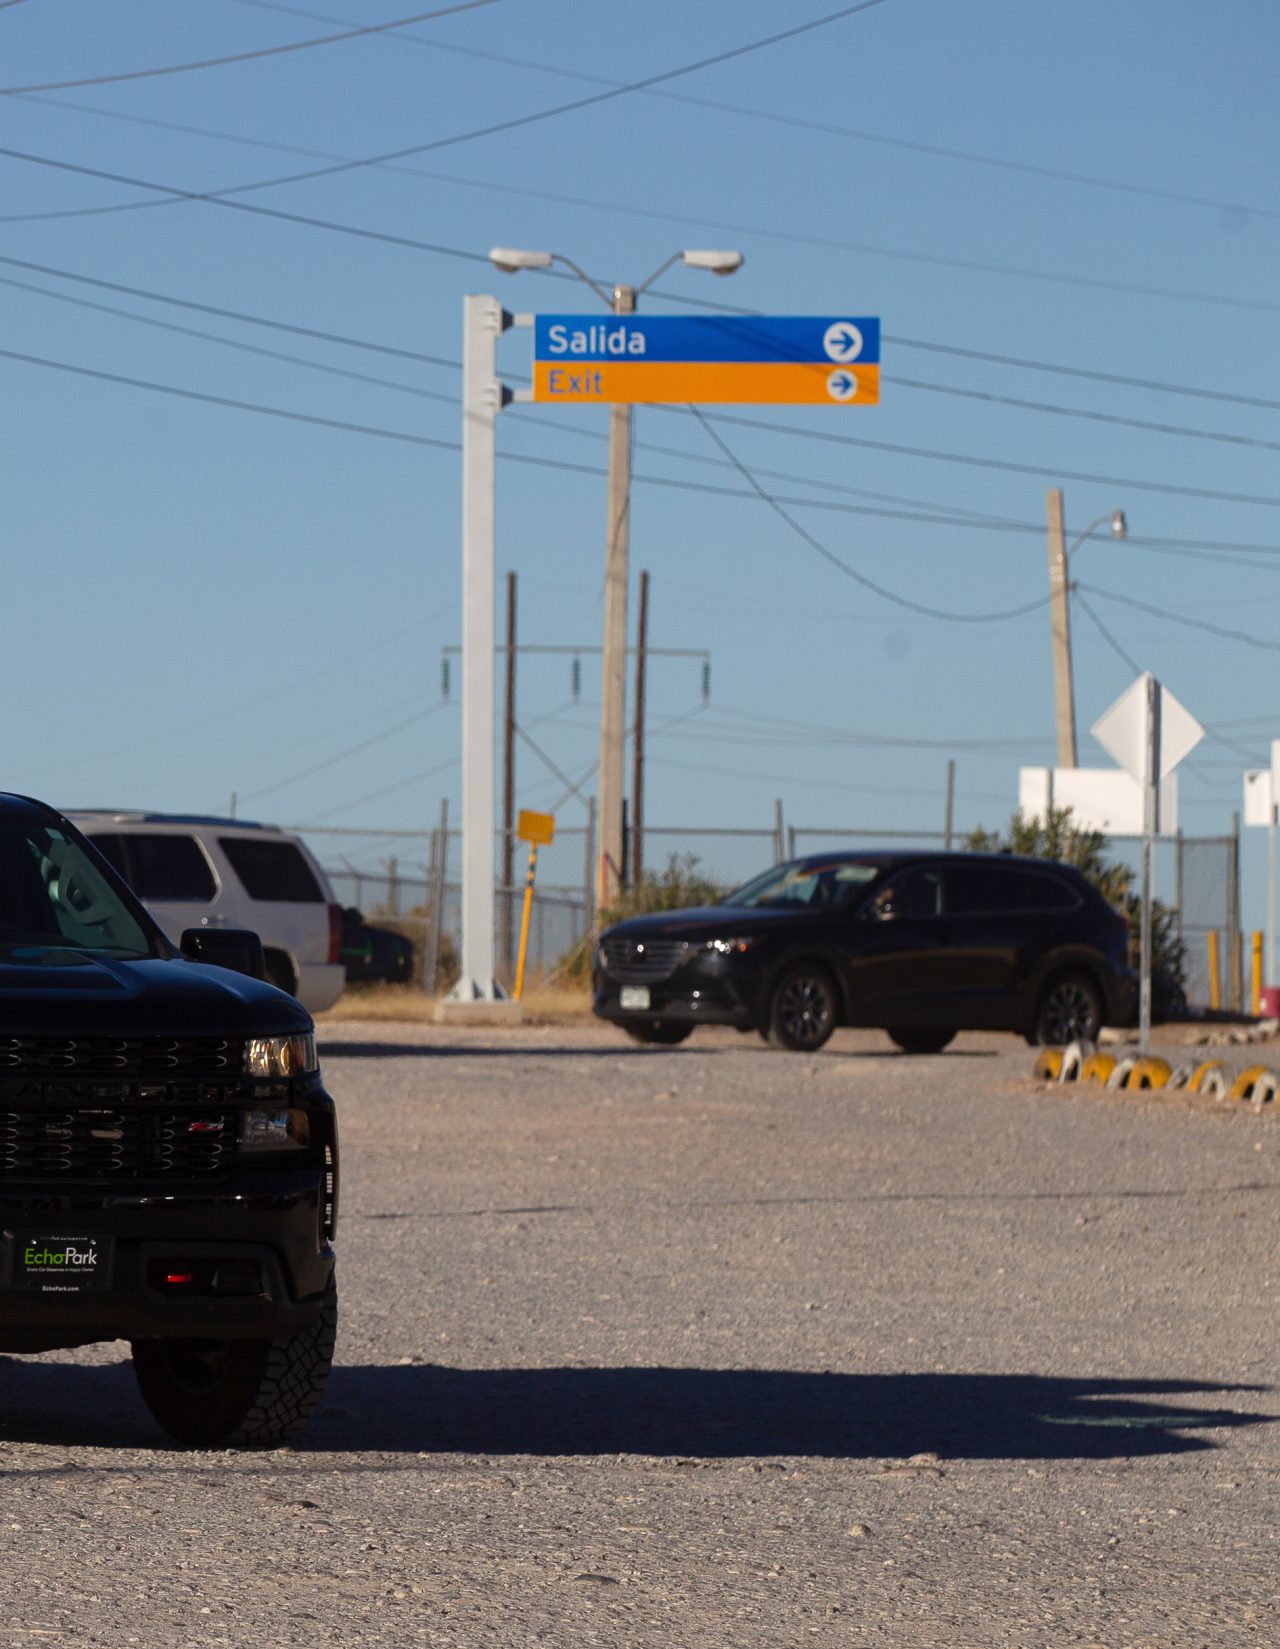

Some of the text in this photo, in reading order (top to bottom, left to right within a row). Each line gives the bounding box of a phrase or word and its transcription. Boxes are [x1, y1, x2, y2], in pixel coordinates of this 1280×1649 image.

[548, 325, 646, 355] Salida
[549, 369, 604, 395] Exit
[25, 1247, 97, 1264] EchoPark
